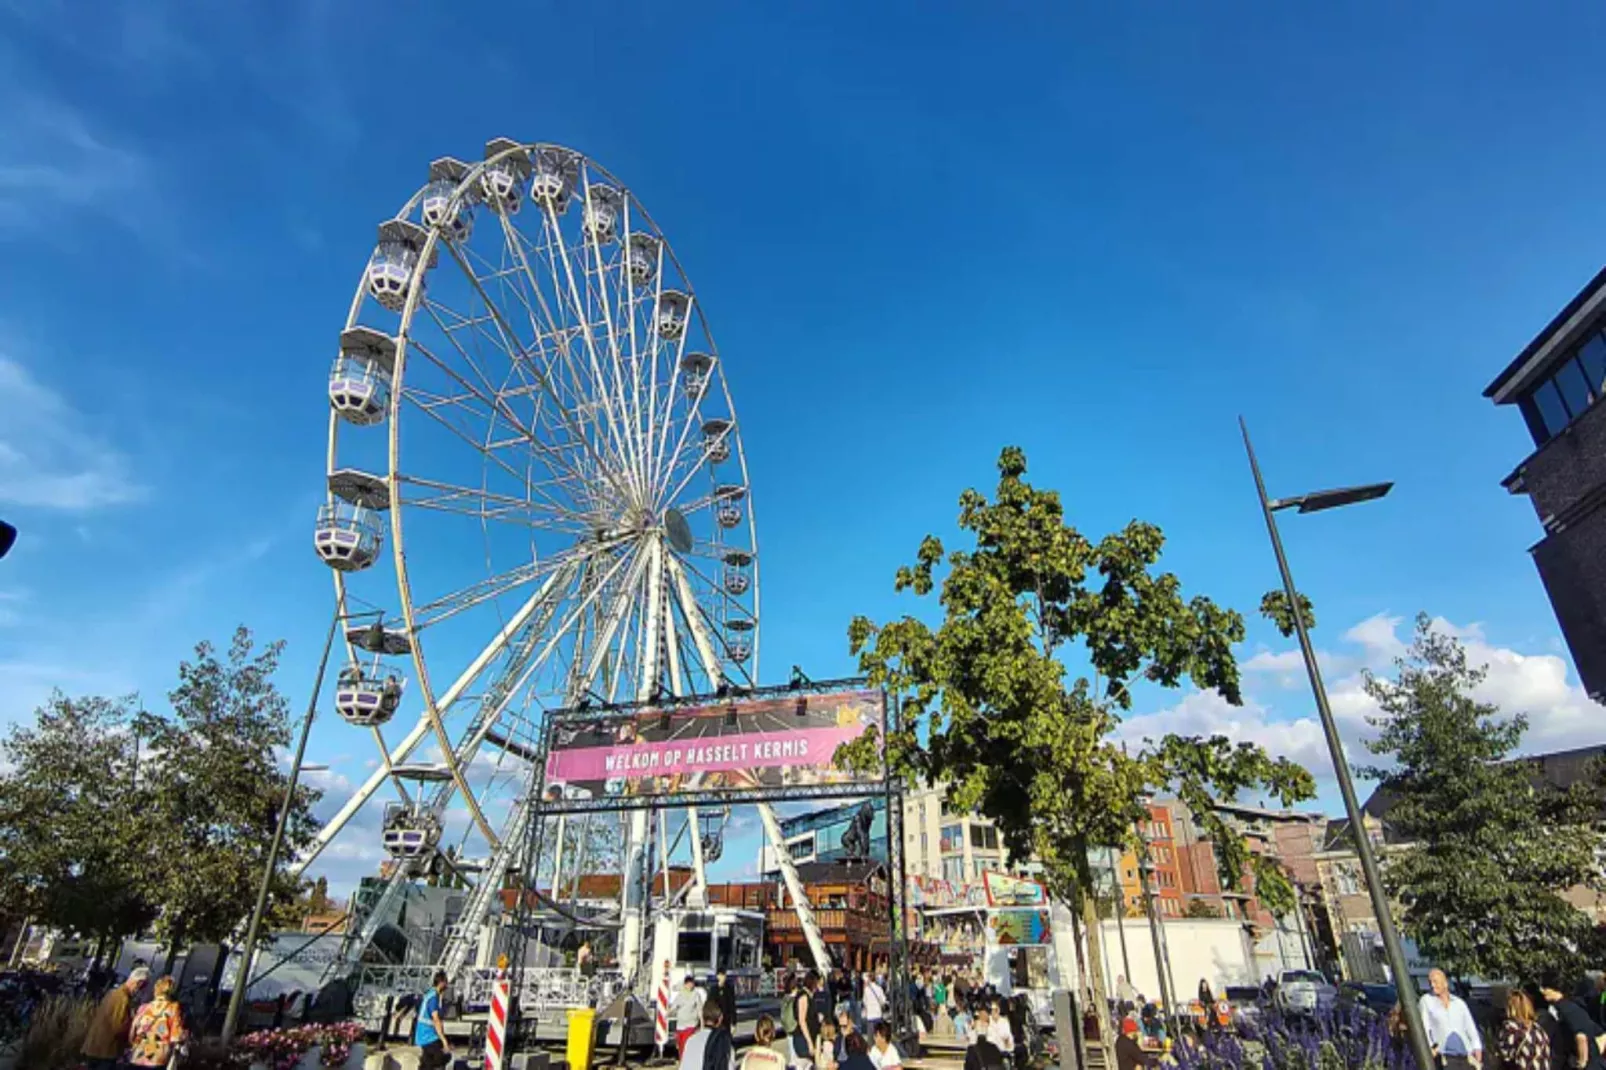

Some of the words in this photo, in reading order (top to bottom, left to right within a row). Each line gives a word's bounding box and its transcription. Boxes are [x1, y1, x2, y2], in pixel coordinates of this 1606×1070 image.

[605, 751, 659, 771] WELKOM
[664, 750, 681, 766] OP
[686, 744, 748, 765] HASSELT
[754, 739, 808, 759] KERMIS
